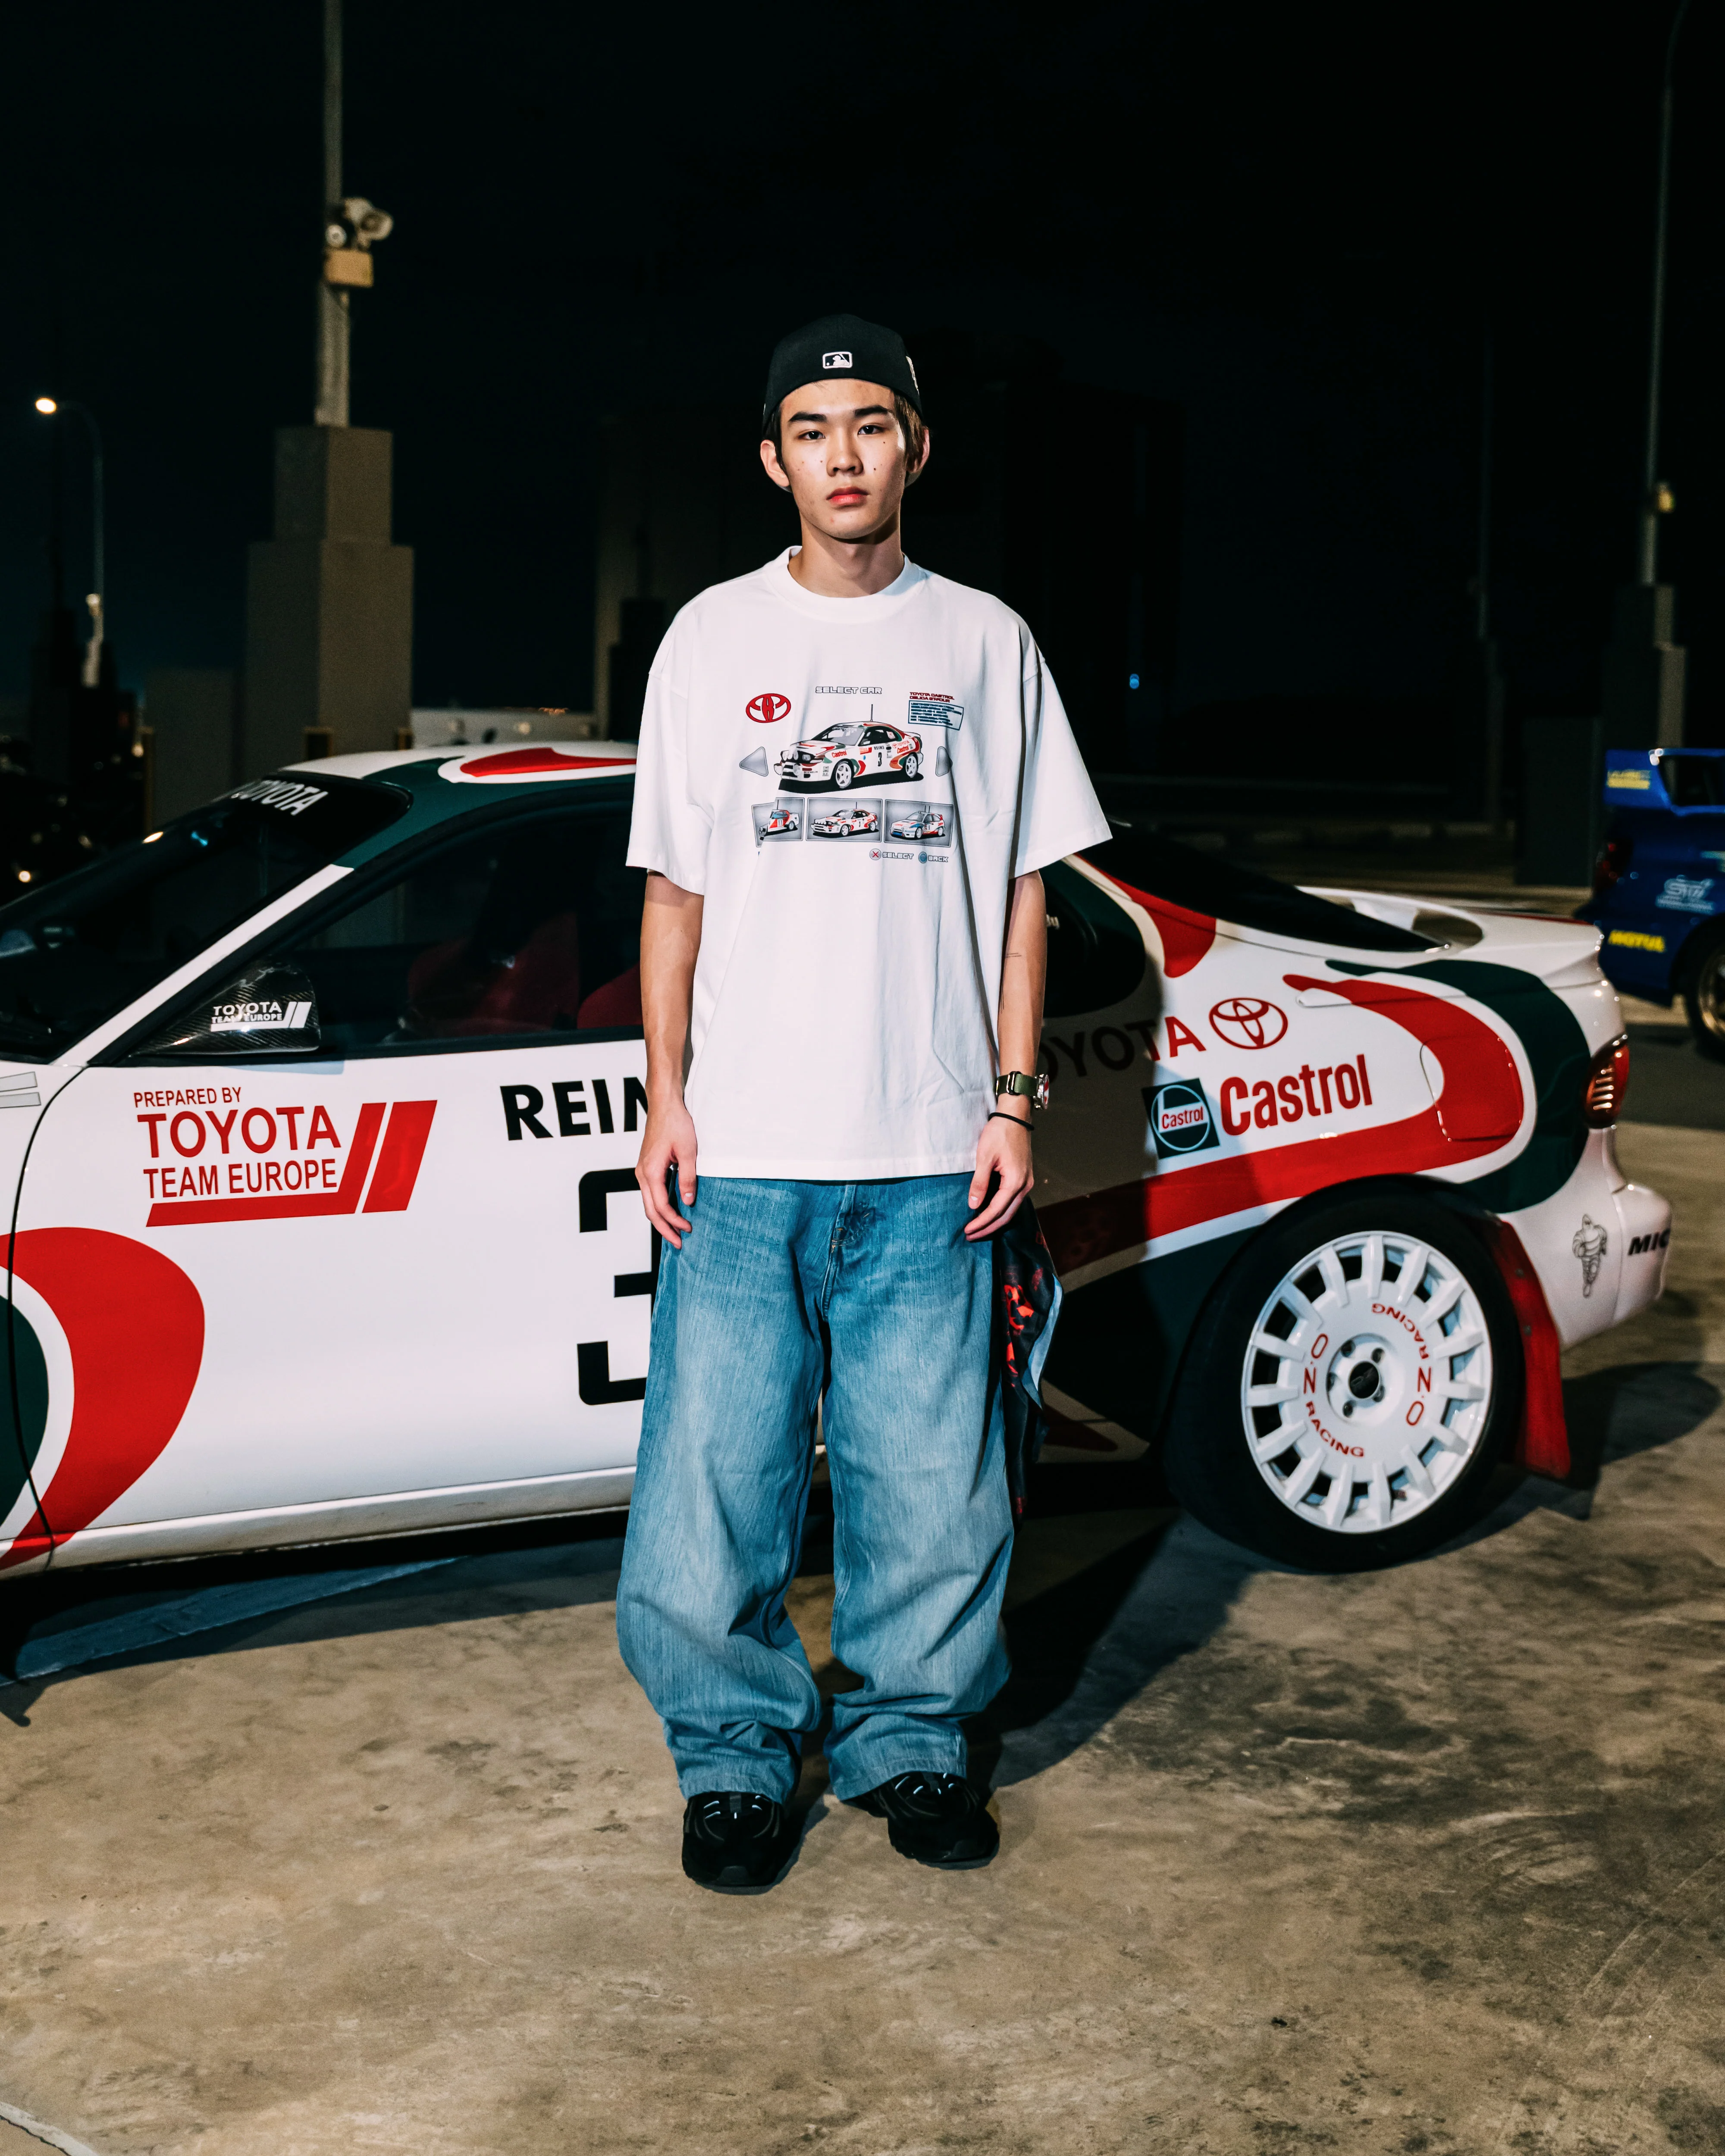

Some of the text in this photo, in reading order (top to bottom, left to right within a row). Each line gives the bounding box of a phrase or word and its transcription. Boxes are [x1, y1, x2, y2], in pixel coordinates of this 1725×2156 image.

[815, 686, 882, 695] SELECT CAR
[831, 750, 847, 758] Castrol
[878, 752, 882, 767] 3
[897, 745, 909, 754] Castrol
[213, 1001, 282, 1016] TOYOTA
[243, 1013, 282, 1022] EUROPE
[134, 1087, 242, 1108] PREPARED BY
[1220, 1054, 1373, 1137] Castrol
[1162, 1106, 1204, 1129] Castrol
[137, 1105, 342, 1158] TOYOTA
[143, 1158, 337, 1199] TEAM EUROPE
[577, 1167, 673, 1405] 3
[1371, 1302, 1429, 1360] RACING
[1305, 1401, 1364, 1457] RACING
